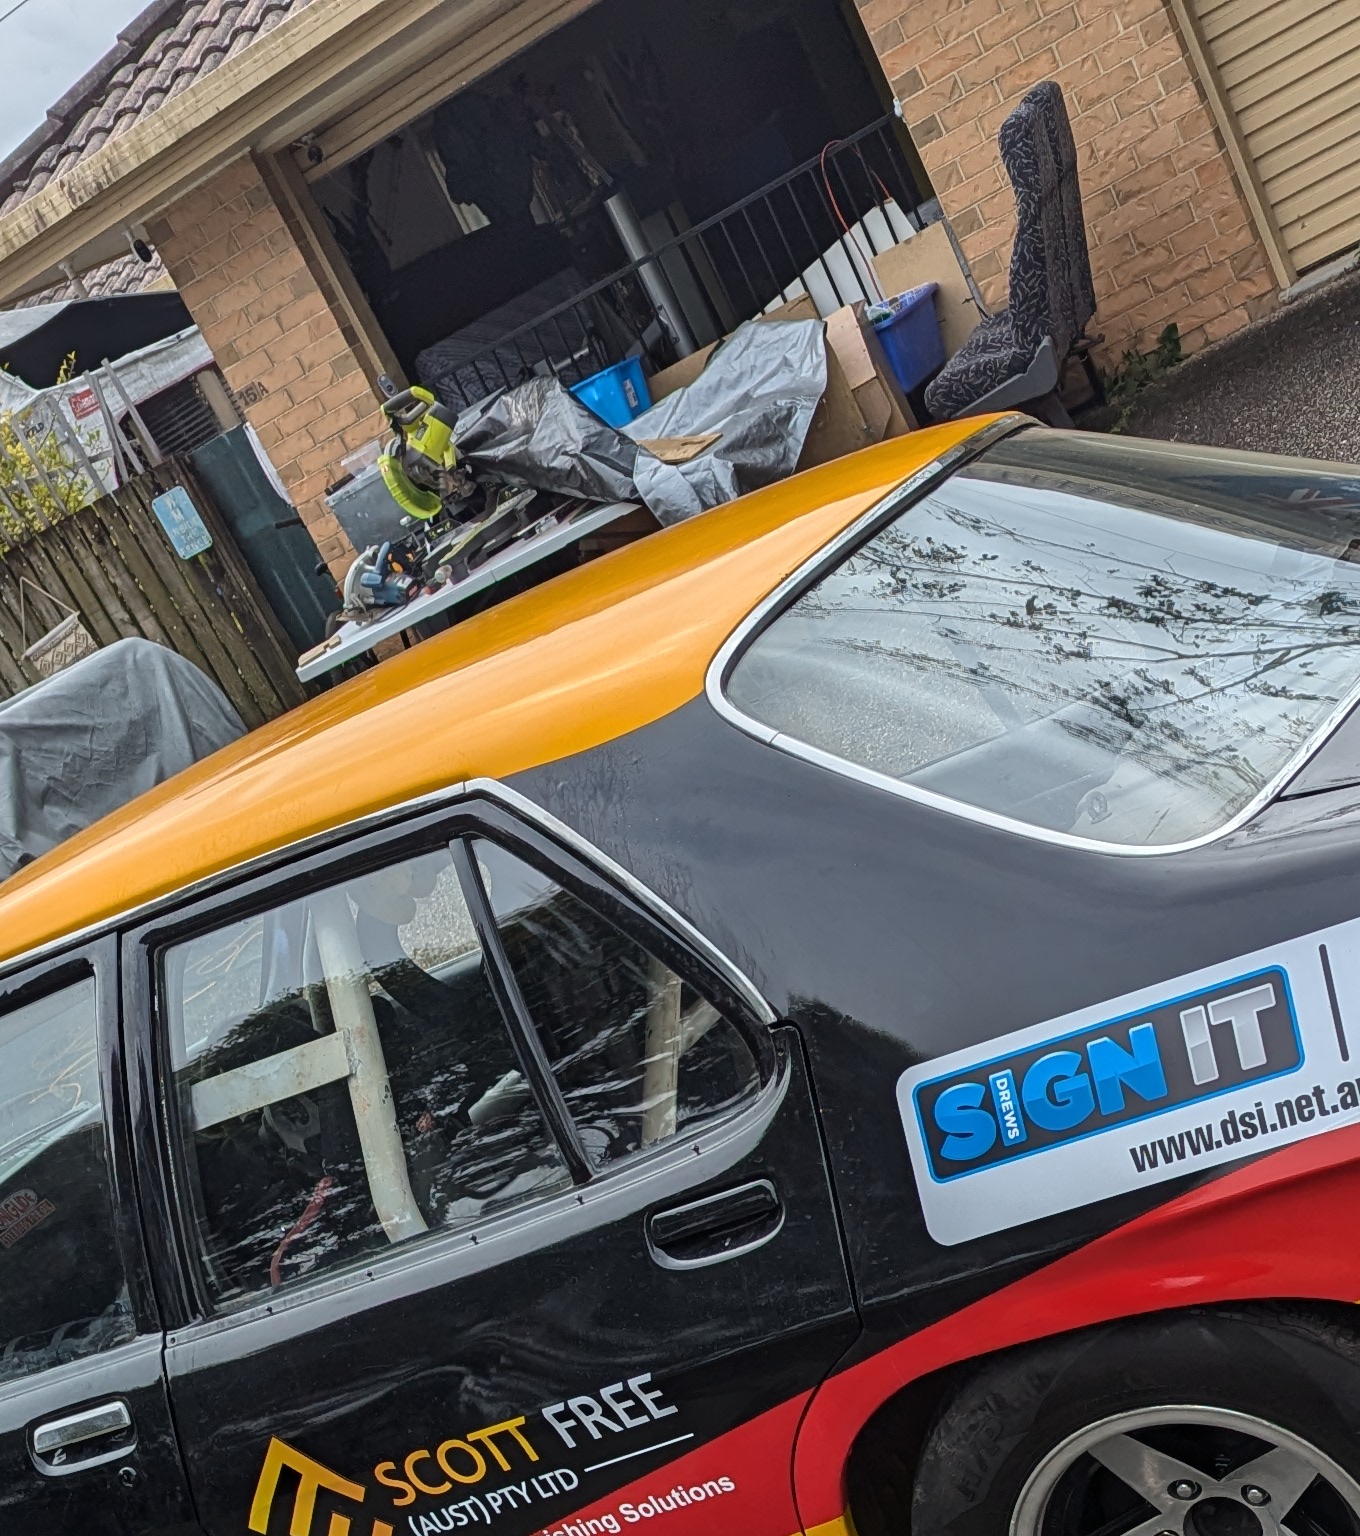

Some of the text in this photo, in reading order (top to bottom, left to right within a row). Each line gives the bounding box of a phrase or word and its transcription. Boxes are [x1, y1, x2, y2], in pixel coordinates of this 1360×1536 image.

[1180, 983, 1278, 1087] IT
[994, 1077, 1020, 1140] DREWS
[374, 1372, 678, 1506] SCOTT FREE
[488, 1480, 535, 1515] PTY
[527, 1467, 578, 1503] LTD
[618, 1472, 736, 1522] Solutions
